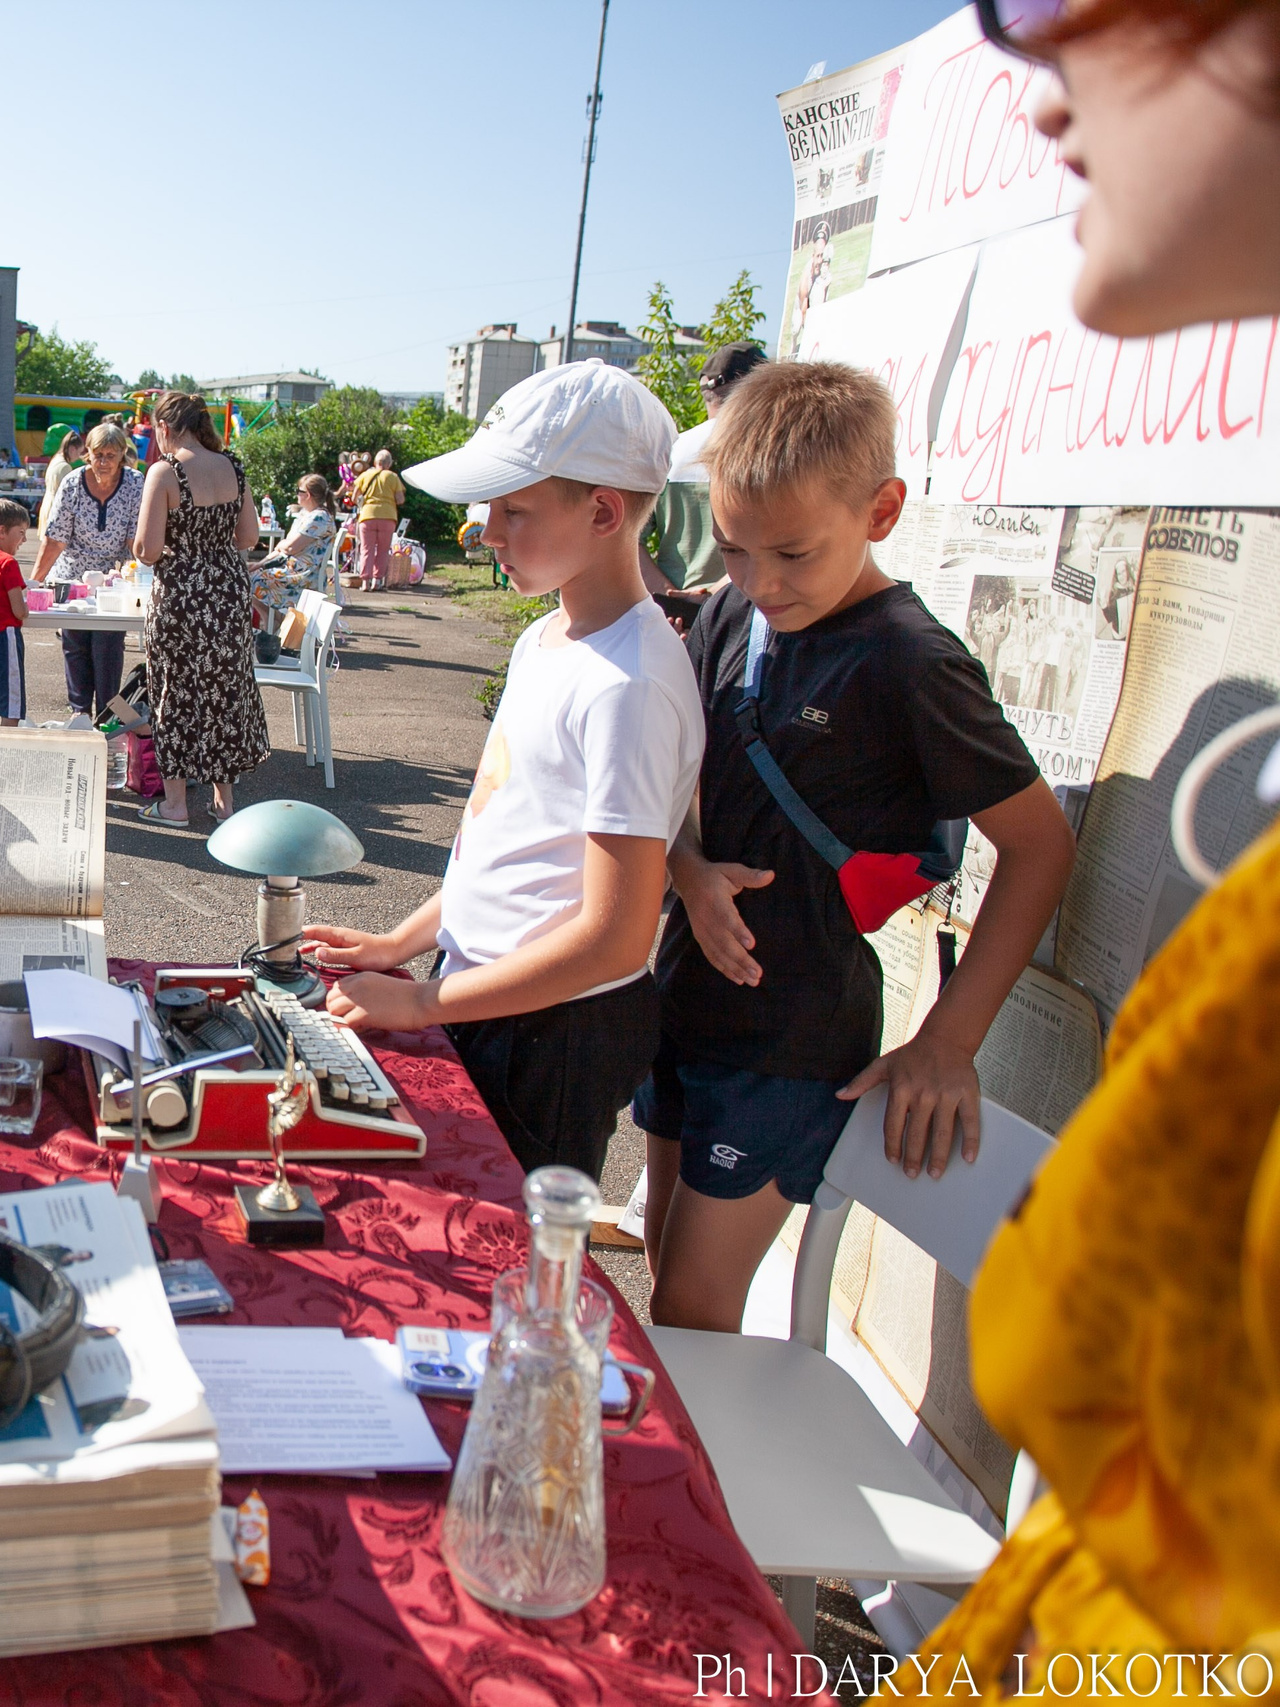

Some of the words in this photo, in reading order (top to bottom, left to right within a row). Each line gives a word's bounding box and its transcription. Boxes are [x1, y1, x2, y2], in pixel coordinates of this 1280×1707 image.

[783, 92, 860, 132] КАНСКИЕ
[788, 105, 876, 162] ВЕДОМОСТИ
[1146, 527, 1239, 563] СОВЕТОВ
[1149, 610, 1204, 631] кукурузоводы
[66, 758, 76, 781] Новый
[61, 822, 69, 844] задачи
[1008, 990, 1062, 1028] ополнение
